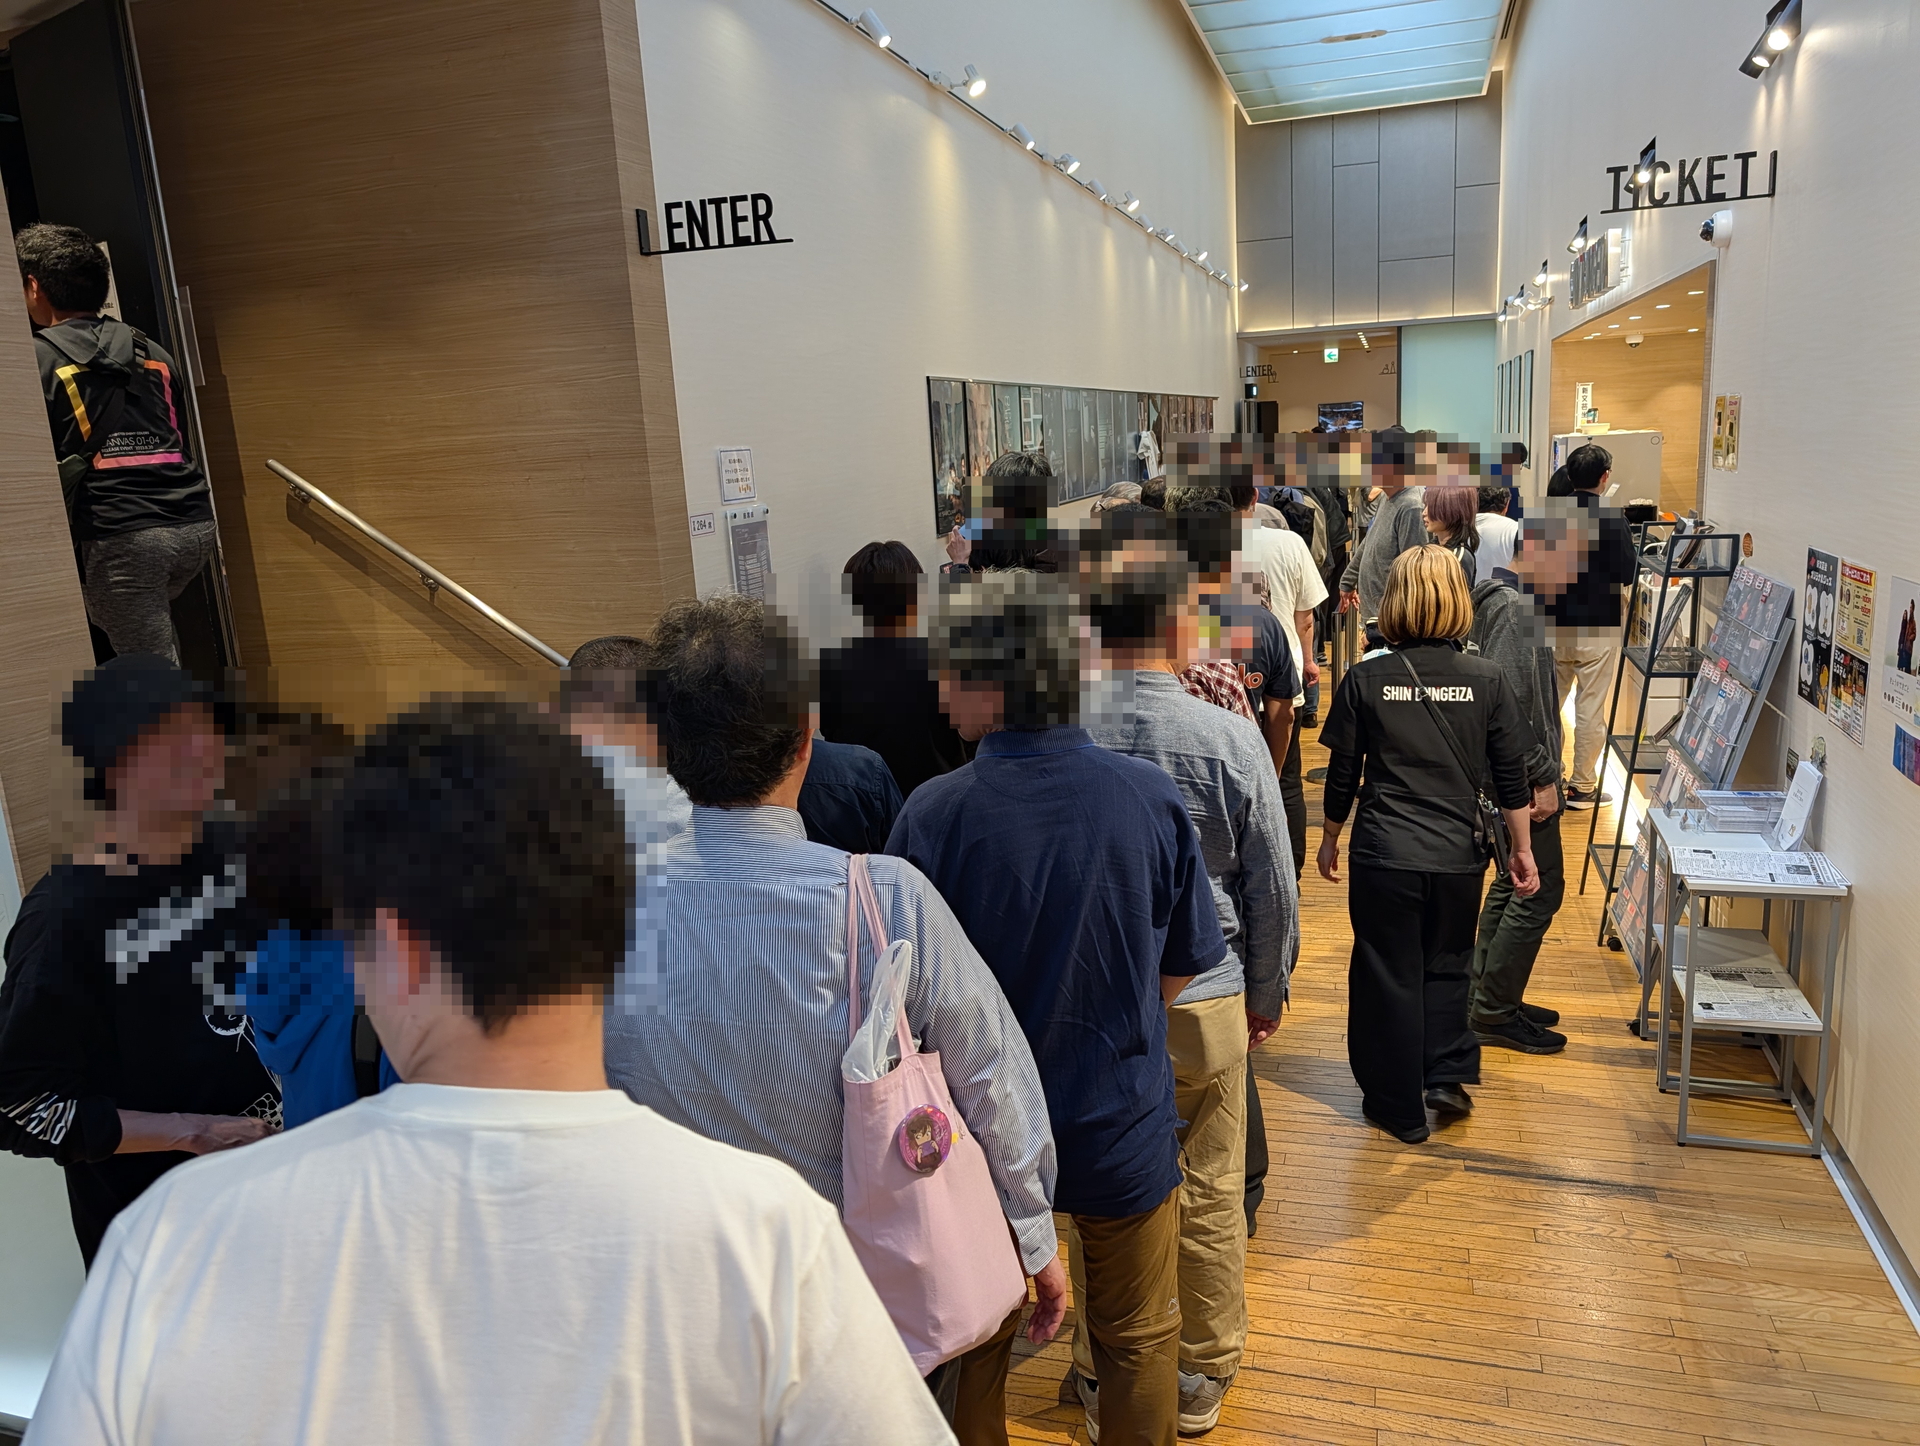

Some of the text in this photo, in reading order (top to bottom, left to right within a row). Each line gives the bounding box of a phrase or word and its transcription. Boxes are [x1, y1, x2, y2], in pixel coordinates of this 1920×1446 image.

[1606, 151, 1757, 211] TICKET
[664, 193, 777, 251] ENTER
[1246, 364, 1273, 378] ENTER
[101, 436, 135, 448] ANVAS
[1383, 686, 1474, 702] SHIN BNGEIZA
